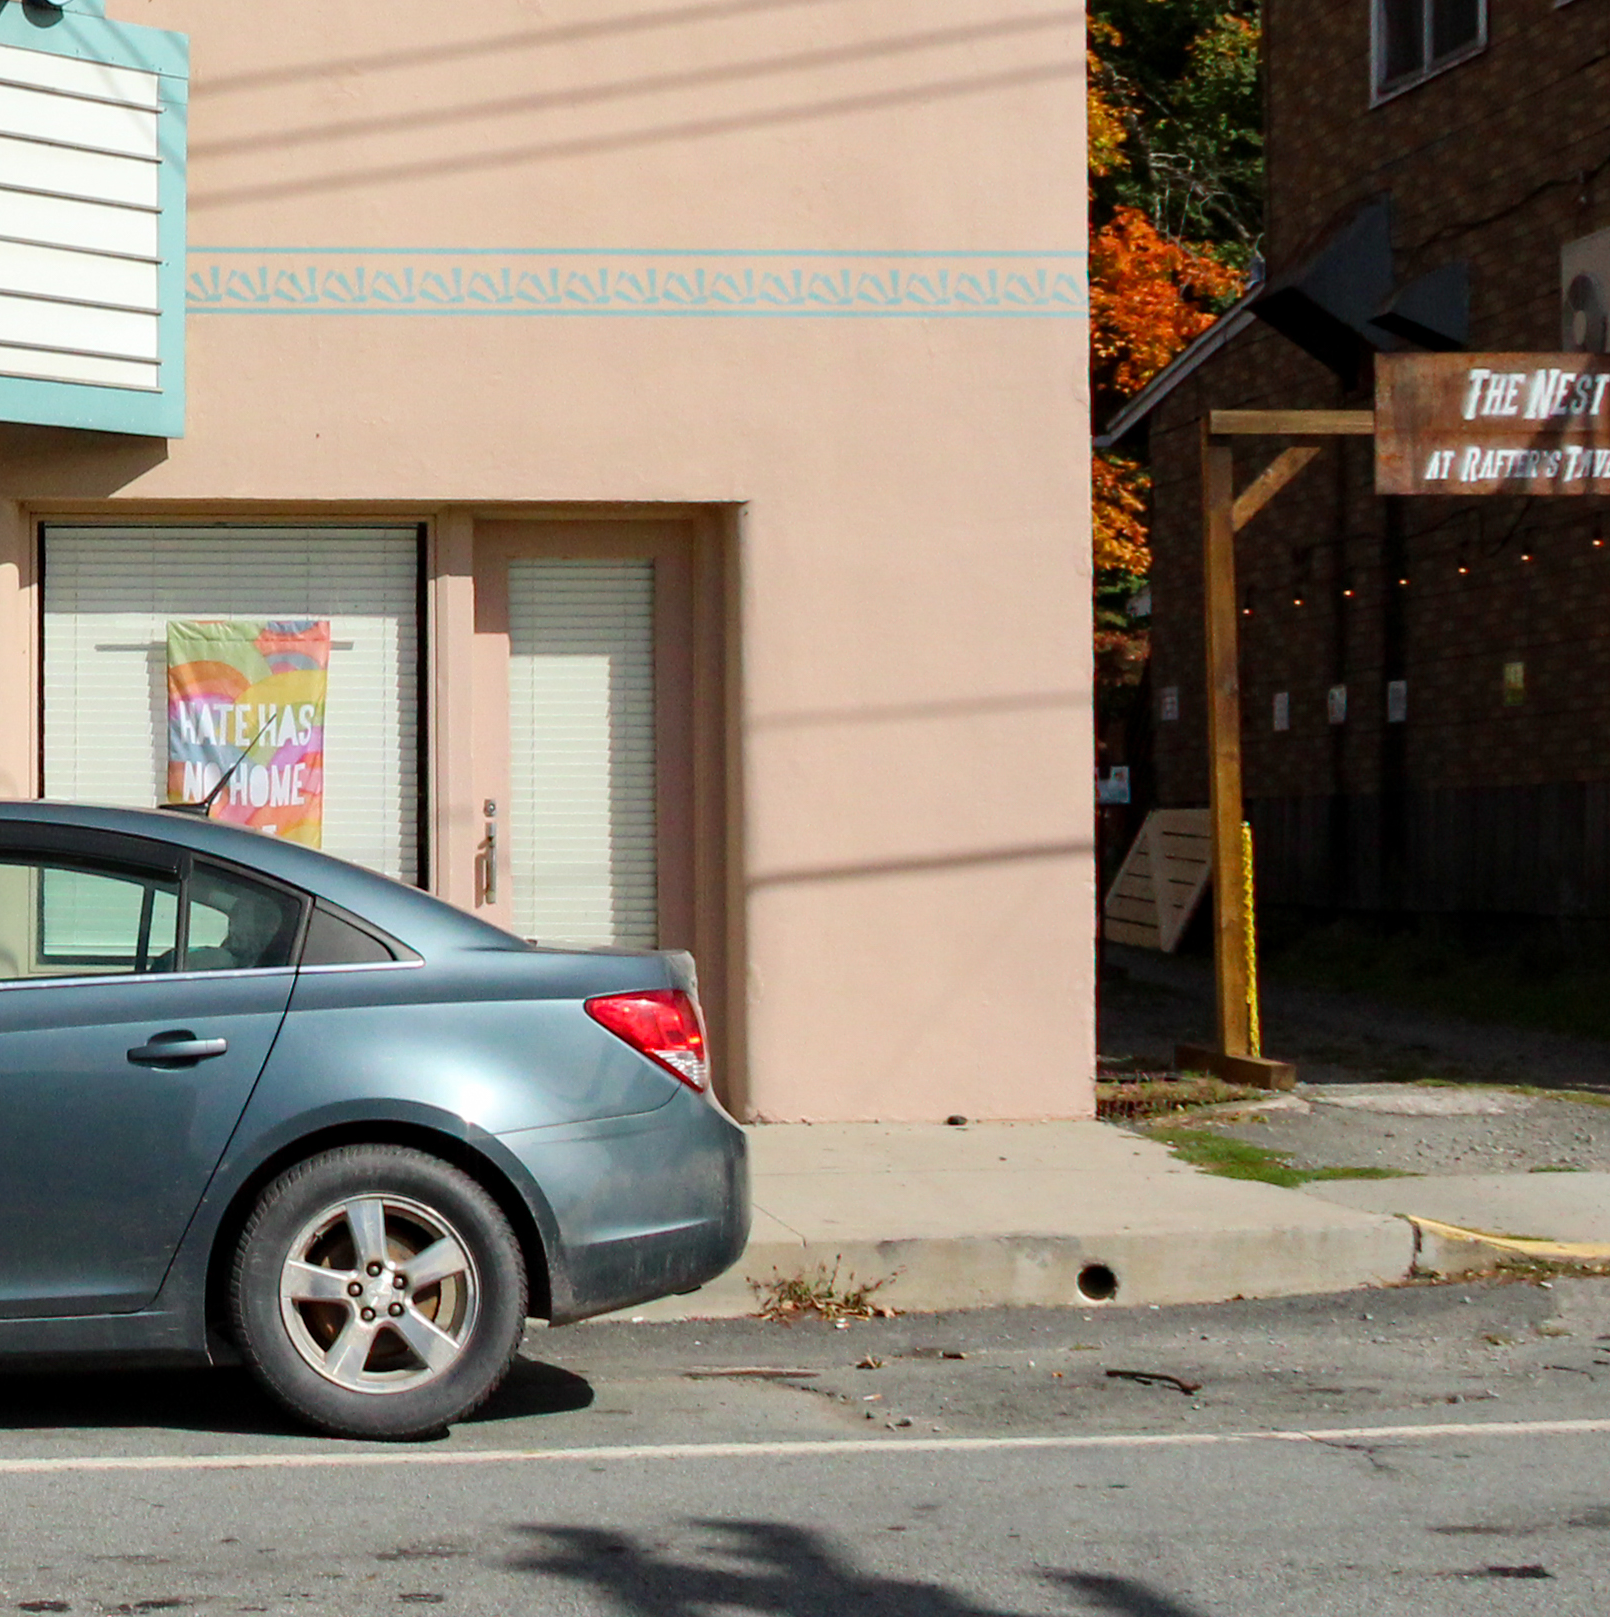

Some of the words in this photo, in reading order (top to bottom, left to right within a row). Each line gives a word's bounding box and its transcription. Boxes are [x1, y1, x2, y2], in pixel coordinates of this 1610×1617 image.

[1464, 368, 1527, 421] THE
[178, 700, 251, 746] HATE
[258, 703, 315, 747] HAS
[183, 760, 222, 805] NO
[229, 762, 307, 808] HOME
